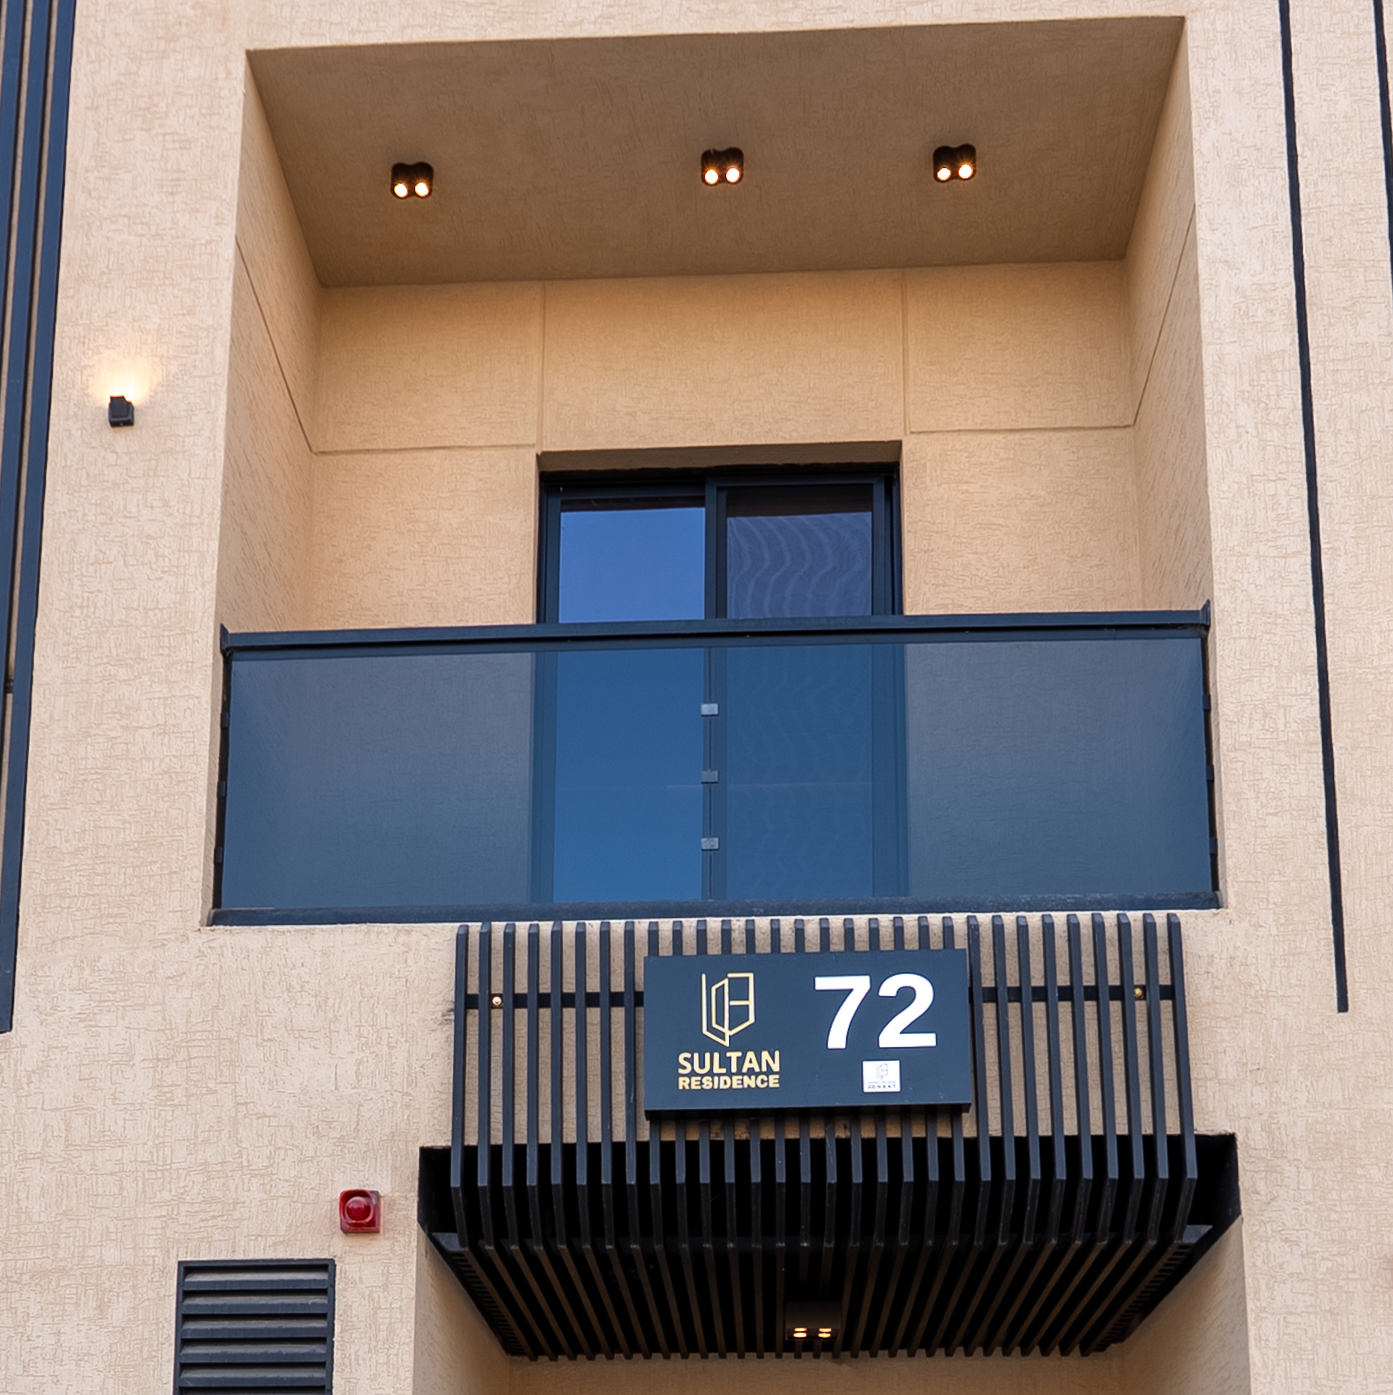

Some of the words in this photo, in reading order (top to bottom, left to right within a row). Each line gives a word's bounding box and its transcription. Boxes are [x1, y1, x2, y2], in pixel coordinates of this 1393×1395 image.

[814, 973, 937, 1049] 72
[678, 1050, 780, 1074] SULTAN
[678, 1074, 780, 1090] RESIDENCE
